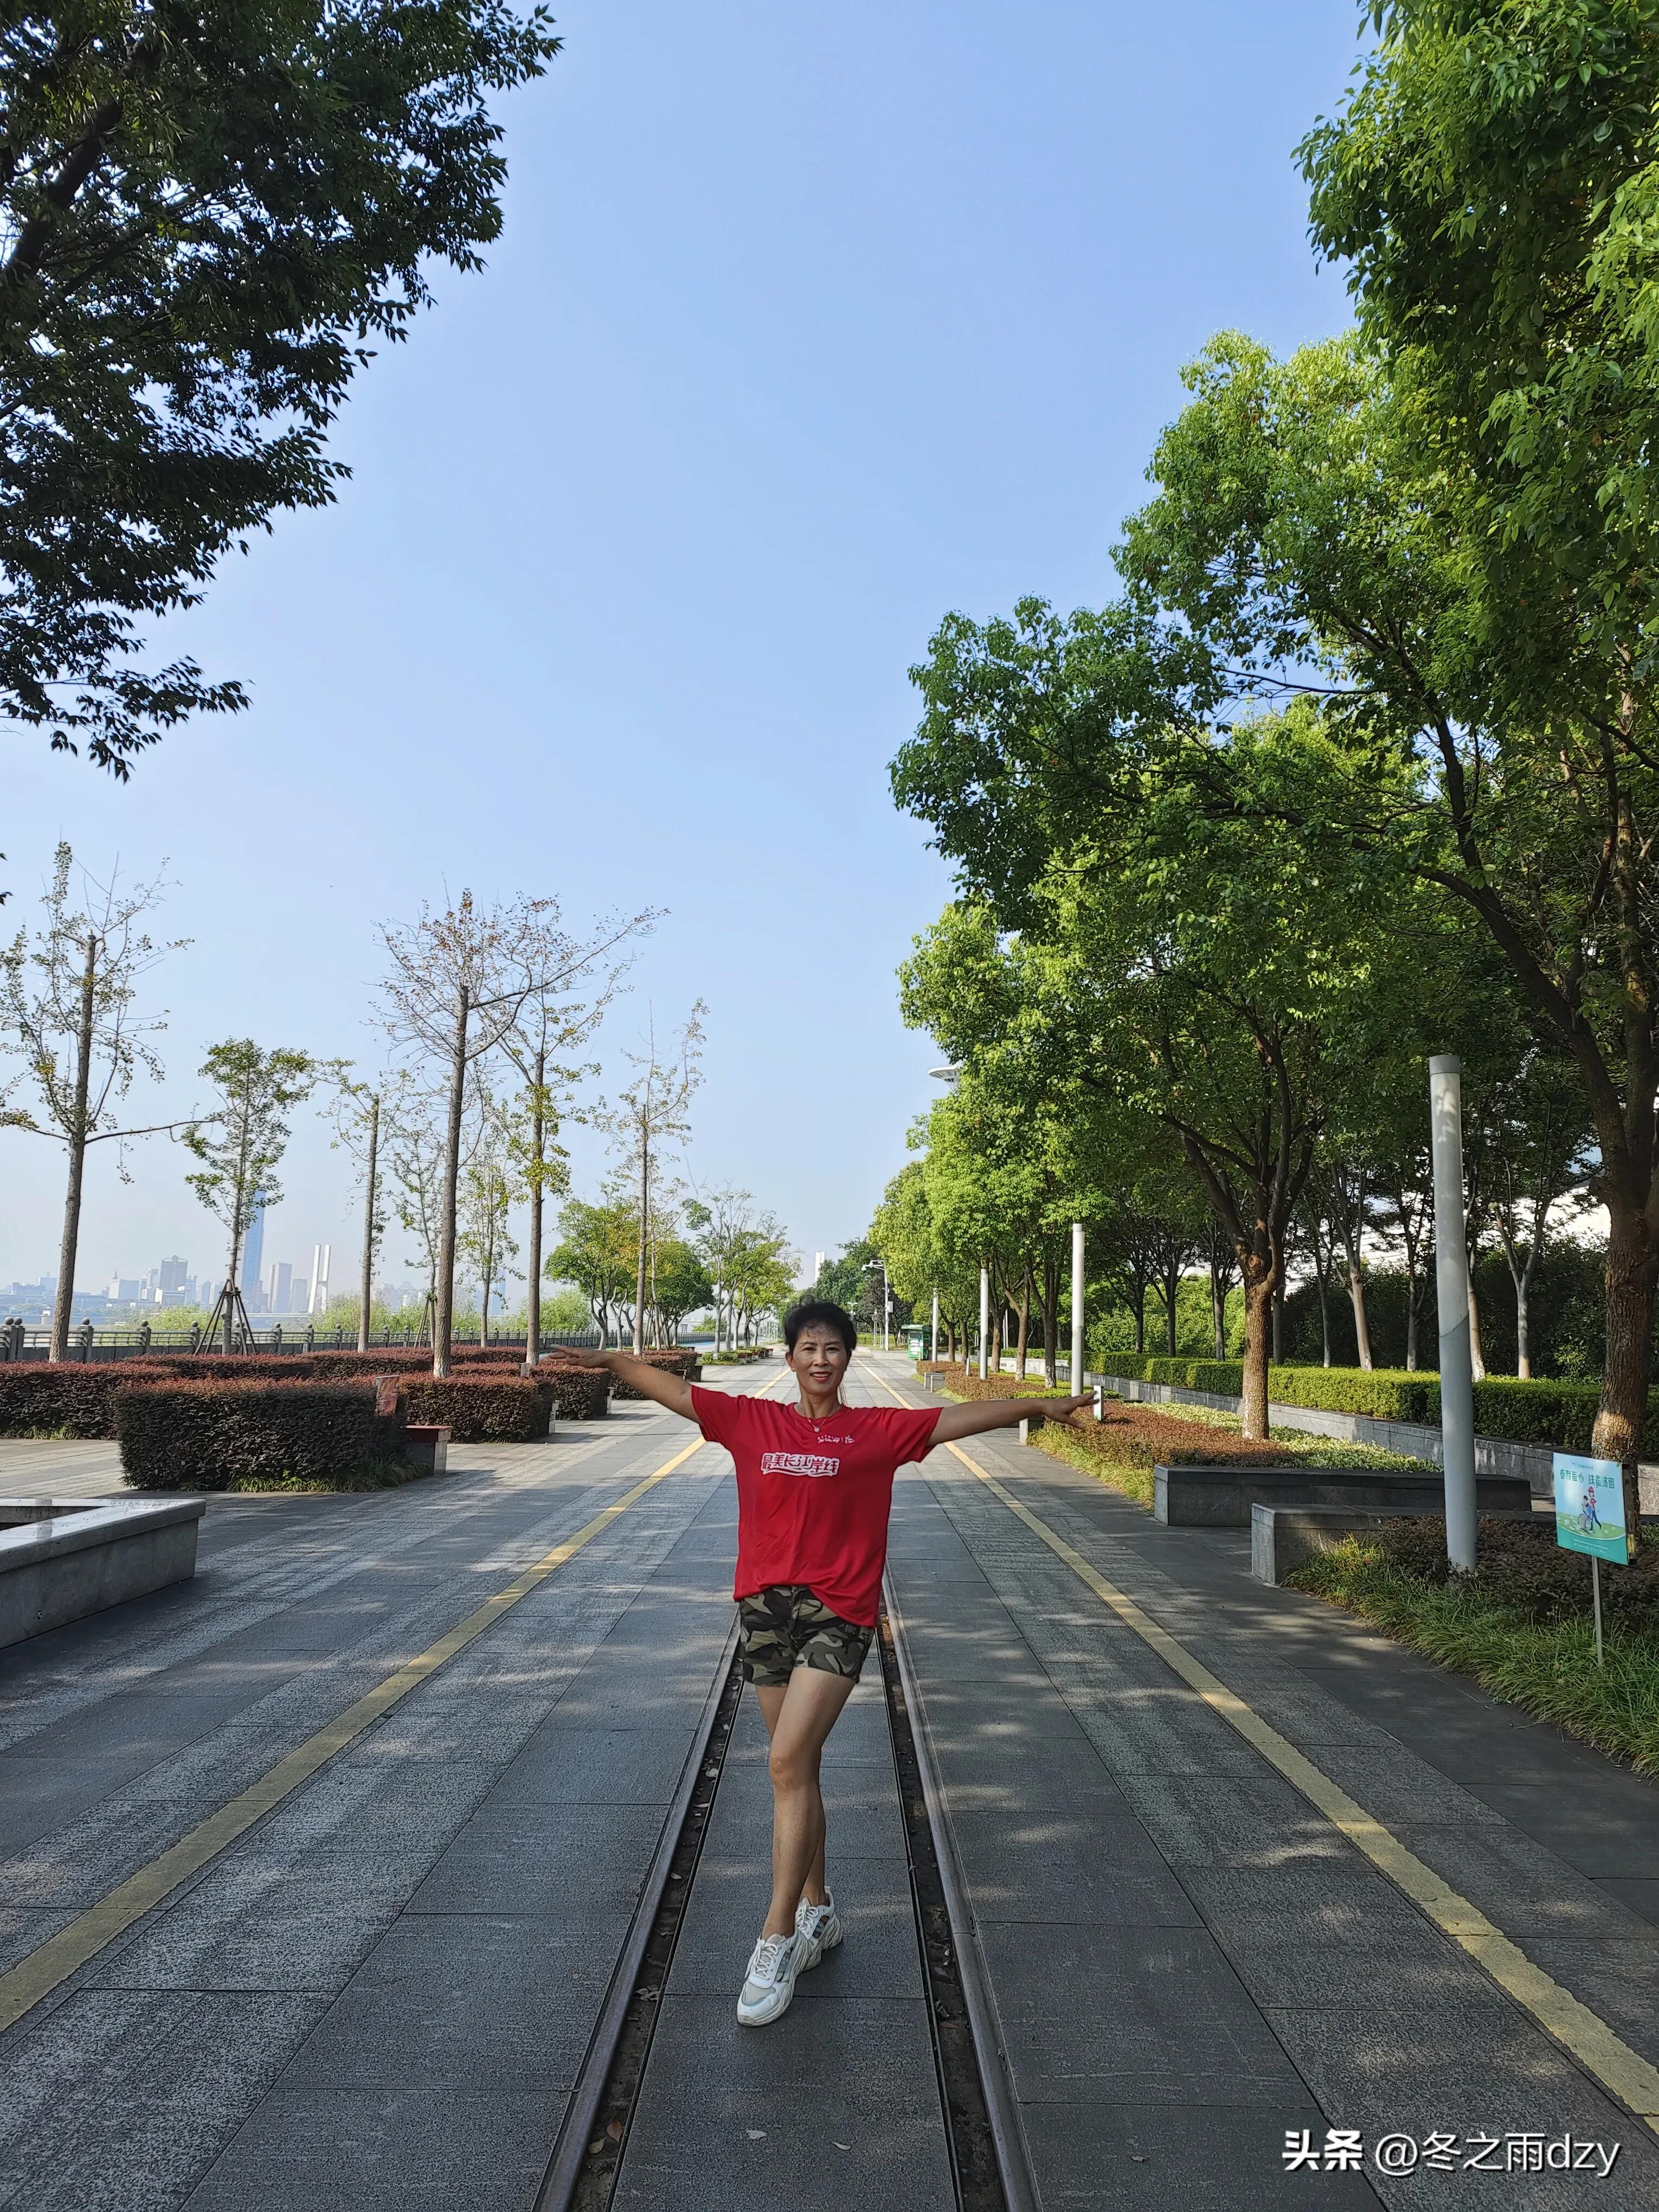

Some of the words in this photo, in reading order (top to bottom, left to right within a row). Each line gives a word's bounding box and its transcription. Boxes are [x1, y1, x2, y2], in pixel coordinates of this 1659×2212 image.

[762, 1453, 838, 1474] 最美长江岸线
